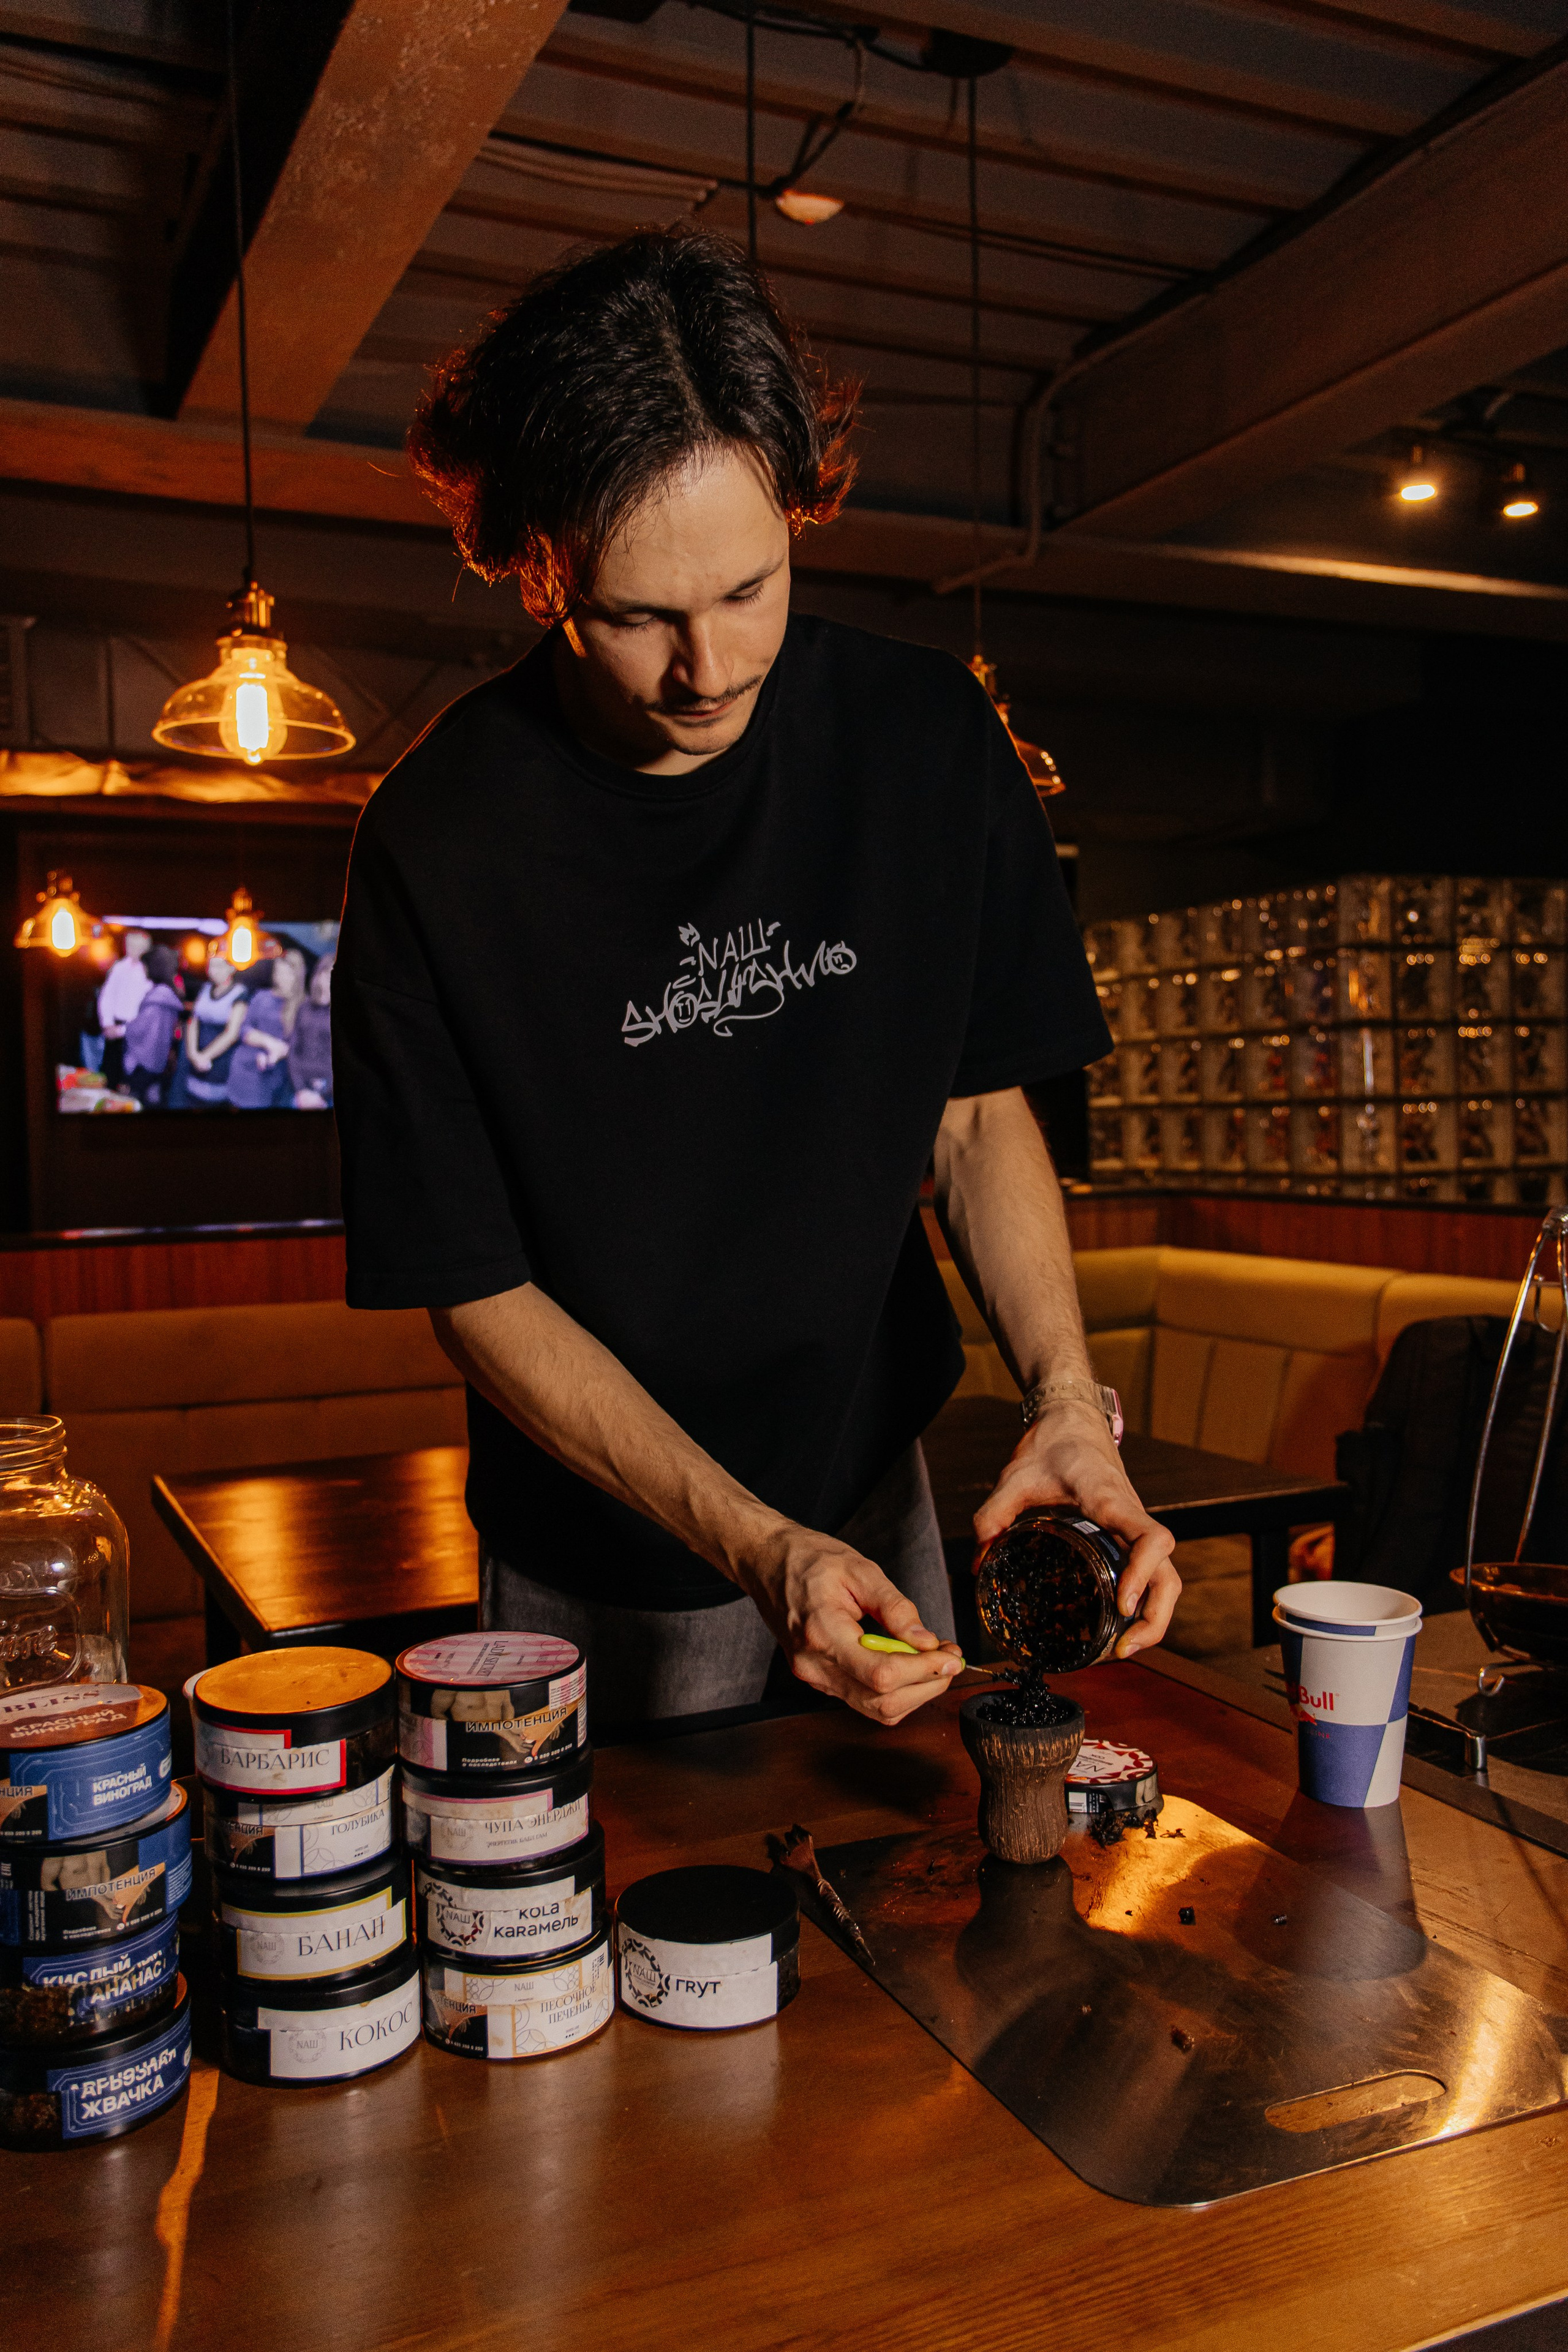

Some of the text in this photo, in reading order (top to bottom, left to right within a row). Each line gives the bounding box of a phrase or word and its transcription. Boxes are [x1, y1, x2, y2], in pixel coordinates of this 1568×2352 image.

[1298, 1686, 1335, 1711] Bull
[13, 1709, 116, 1732] КРАСНЫЙ
[466, 1706, 568, 1733] ИМПОТЕНЦИЯ
[221, 1749, 330, 1770] БАРБАРИС
[92, 1763, 146, 1793] КРАСНЫЙ
[93, 1775, 152, 1806] ВИНОГРАД
[331, 1809, 385, 1835] ГОЛУБИКА
[66, 1868, 156, 1900] ИМПОТЕНЦИЯ
[298, 1915, 385, 1957] БАНАН
[90, 1961, 162, 2004] АНАНАС
[541, 1983, 597, 2013] ПЕСОЧНОЕ
[549, 1998, 592, 2024] ПЕЧЕНЬЕ
[340, 2002, 413, 2051] КОКОС
[81, 2075, 164, 2120] ЖВАЧКА
